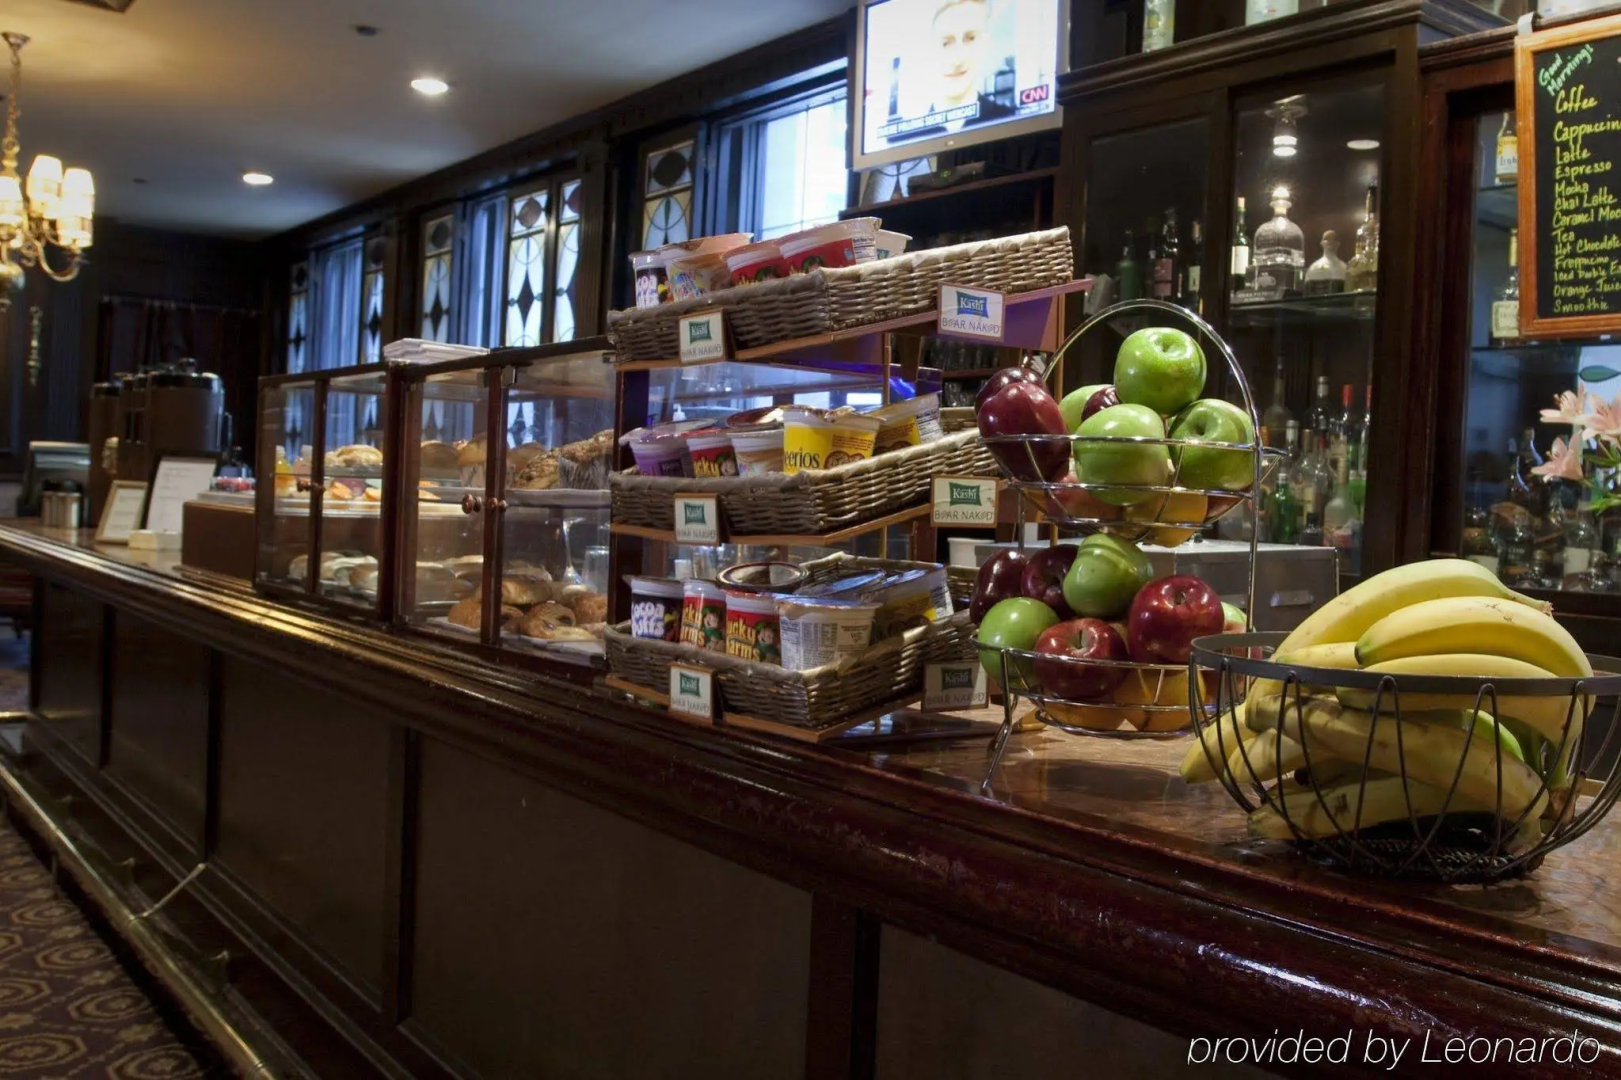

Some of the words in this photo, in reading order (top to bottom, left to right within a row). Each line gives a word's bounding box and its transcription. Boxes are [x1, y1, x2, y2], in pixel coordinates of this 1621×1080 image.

[1021, 85, 1048, 103] CNN
[1555, 84, 1598, 113] Coffee
[1554, 121, 1621, 146] Cappuccin
[1555, 143, 1592, 166] Latte
[1556, 161, 1612, 182] Espresso
[1555, 180, 1590, 199] Mocha
[1554, 195, 1580, 212] Chai
[1582, 186, 1618, 208] Latte
[1553, 209, 1594, 228] Caramel
[1597, 205, 1621, 222] Moc
[1552, 227, 1575, 242] Tea
[1555, 242, 1572, 256] Hot
[1553, 283, 1593, 299] Orange
[960, 297, 985, 311] Kashi
[1554, 298, 1609, 313] Smoothie
[785, 447, 820, 469] eerios
[953, 487, 978, 500] Kashi
[632, 602, 665, 619] ocoa
[726, 617, 756, 647] ucky
[945, 672, 969, 683] Kashi
